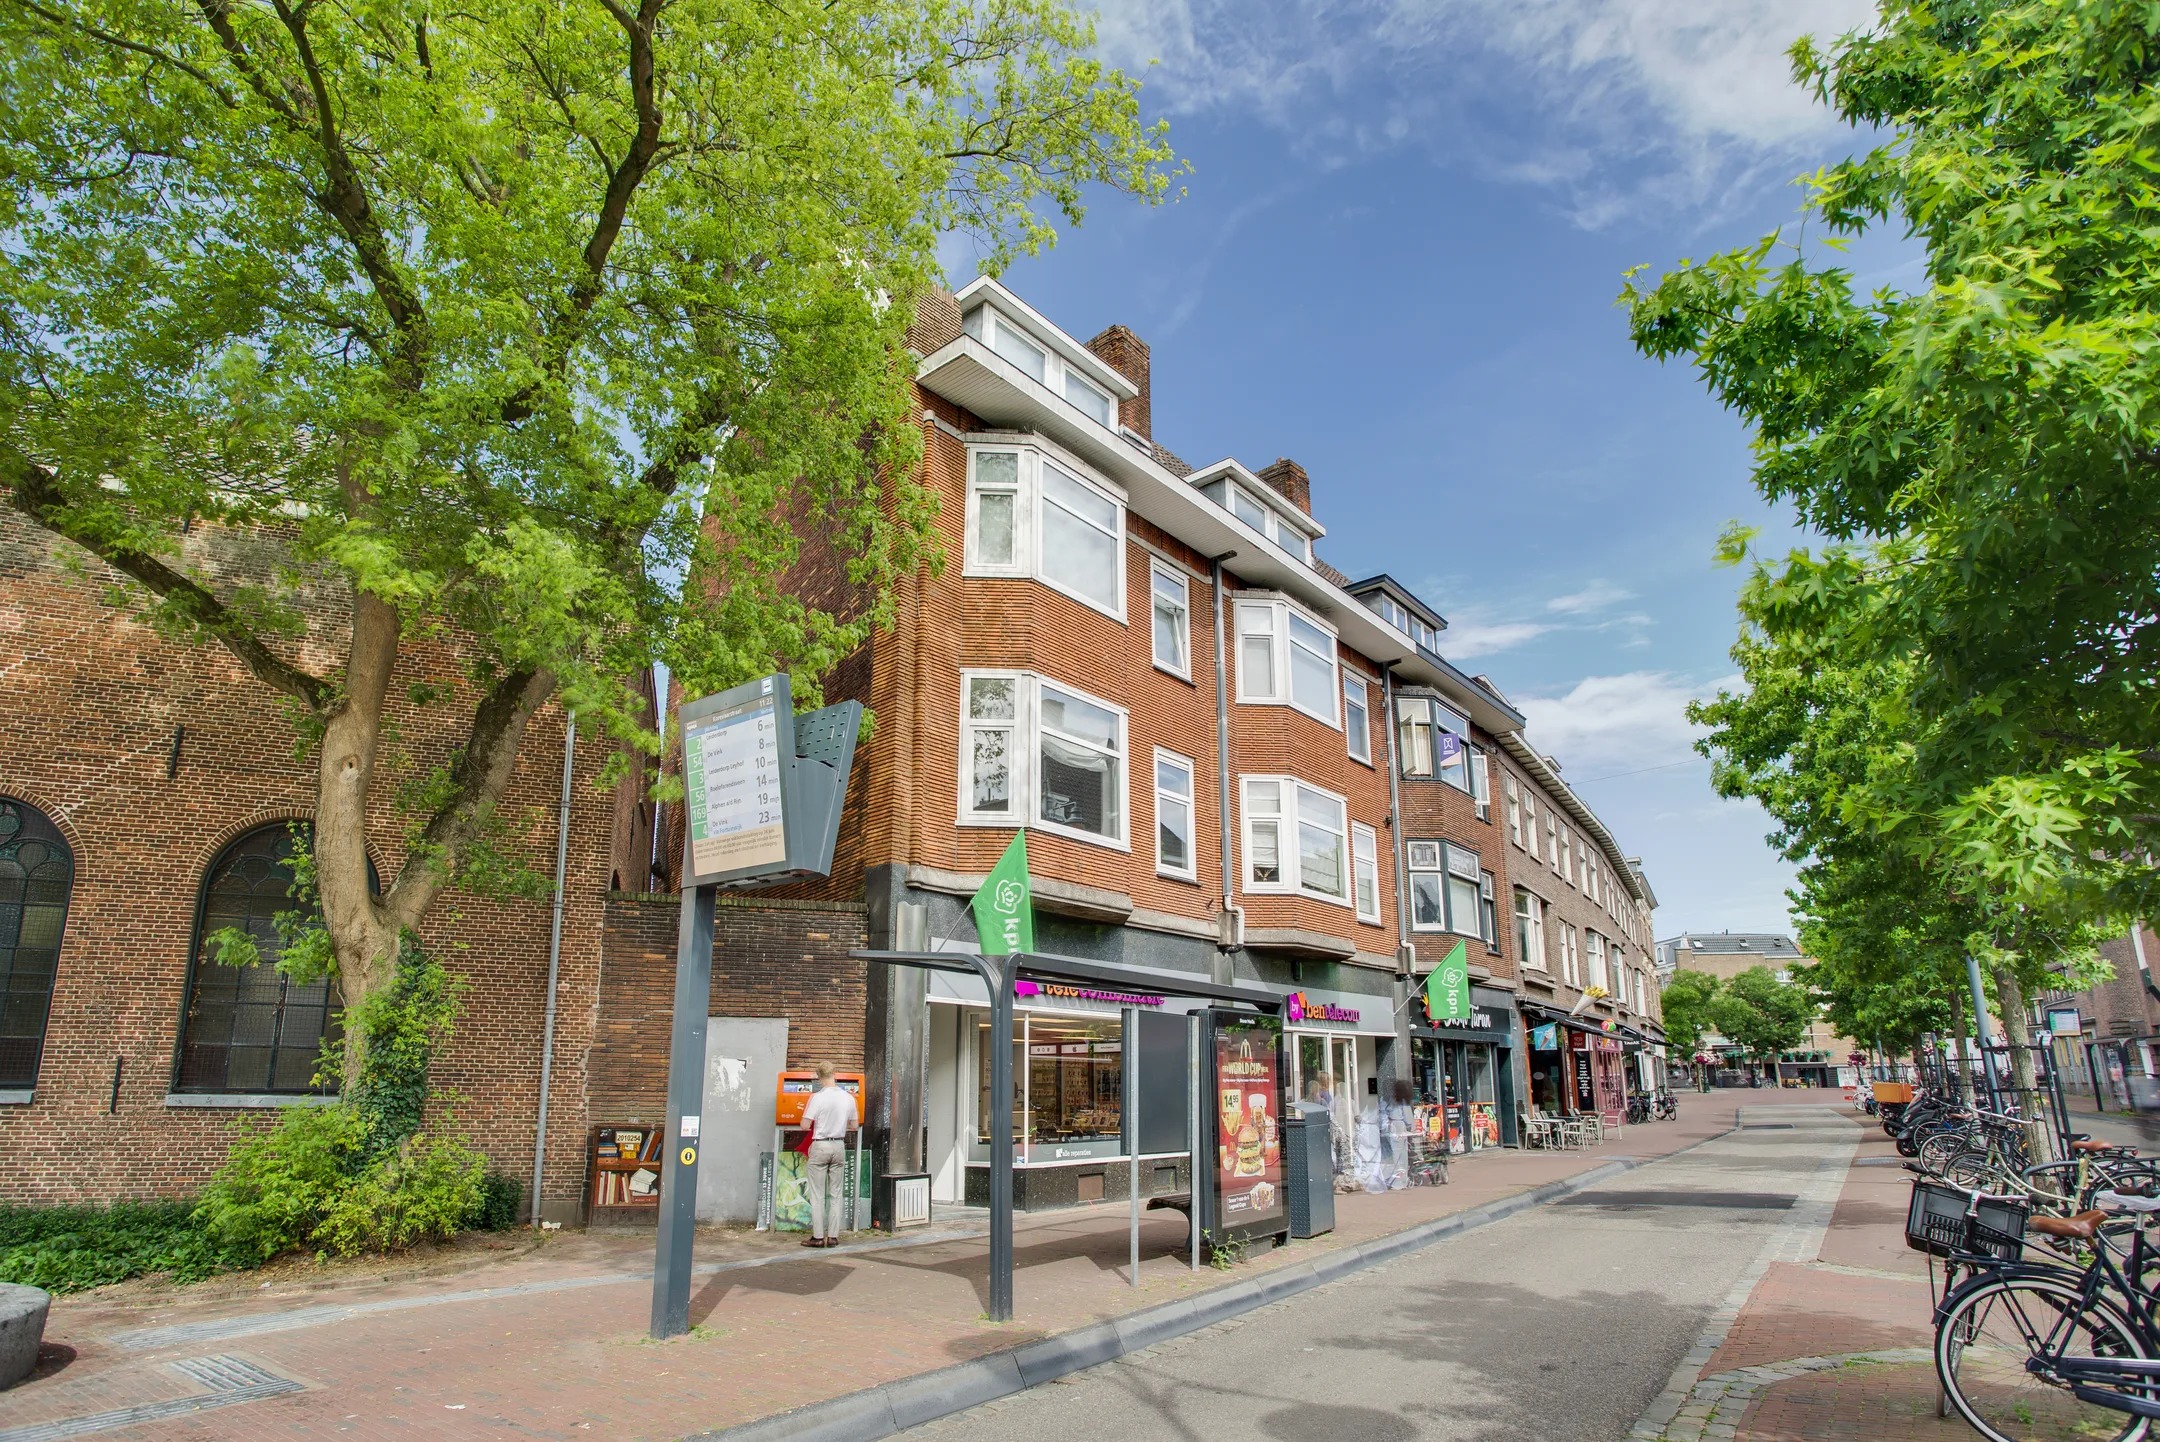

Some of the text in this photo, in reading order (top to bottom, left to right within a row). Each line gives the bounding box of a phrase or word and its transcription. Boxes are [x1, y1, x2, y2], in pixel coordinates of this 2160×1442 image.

[758, 720, 763, 732] 6
[697, 739, 701, 750] 2
[759, 738, 765, 750] 8
[713, 748, 723, 756] Vink
[693, 756, 703, 768] 54
[755, 756, 766, 769] 10
[709, 765, 730, 775] Leiderdorp
[699, 773, 704, 784] 3
[757, 774, 778, 787] 14 min
[695, 791, 705, 803] 56
[757, 793, 768, 806] 19
[711, 802, 726, 810] Alphen
[692, 808, 707, 821] 169
[759, 811, 770, 824] 23
[702, 824, 708, 836] 4
[1291, 1001, 1299, 1014] by
[1446, 989, 1459, 1014] kpn
[1305, 1002, 1360, 1022] bentelecom
[1469, 1004, 1492, 1028] Taran
[1228, 1061, 1250, 1075] WORLD
[1250, 1062, 1261, 1075] CUP
[617, 1134, 641, 1142] 2010254
